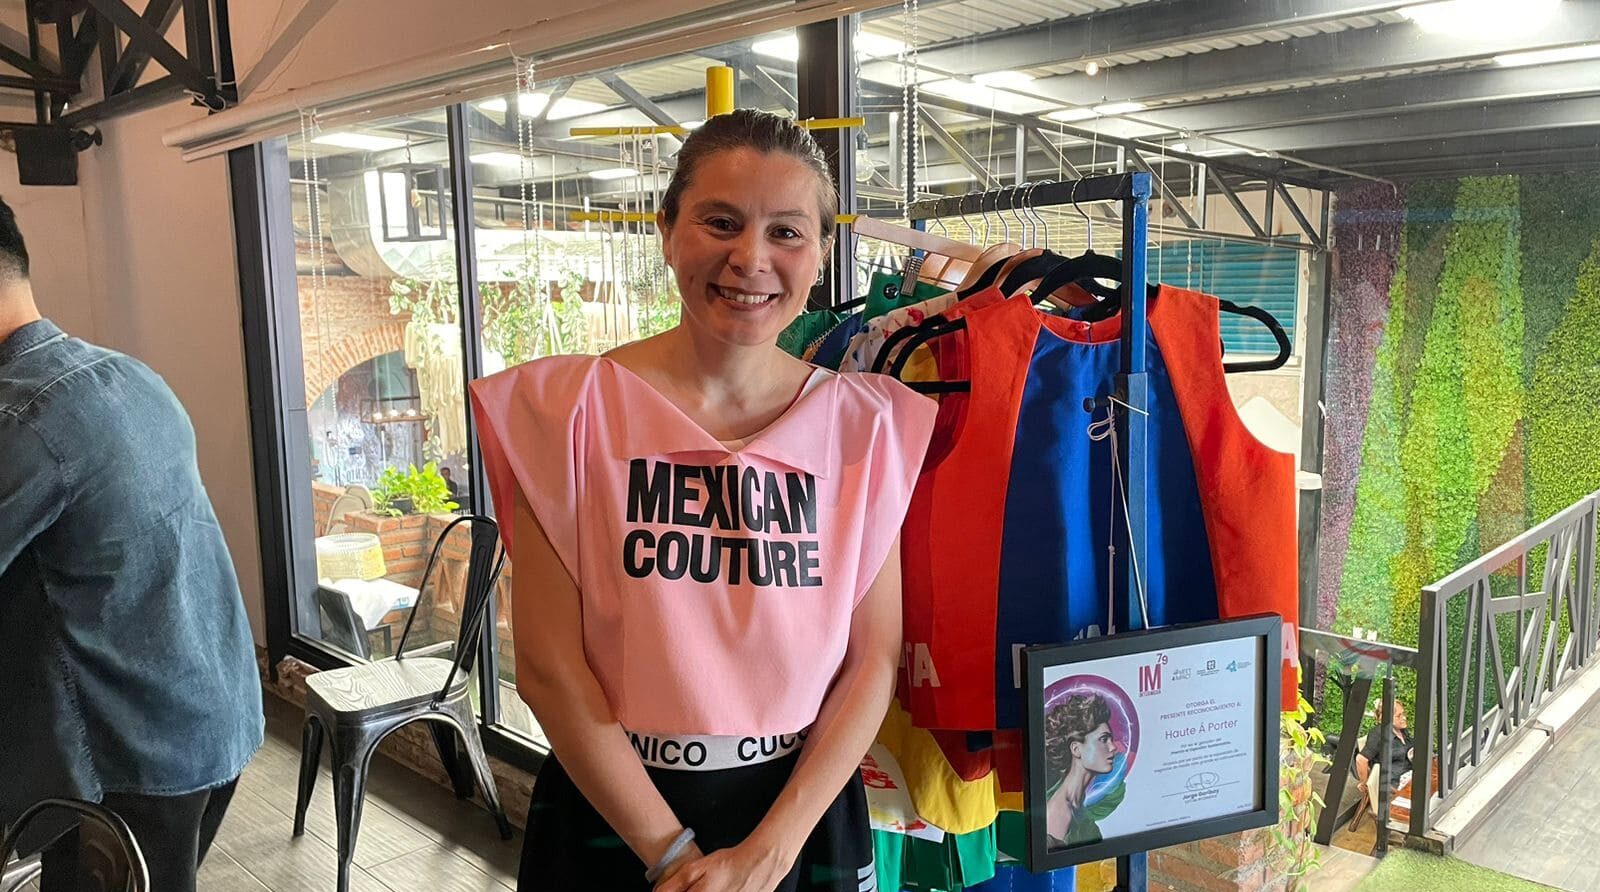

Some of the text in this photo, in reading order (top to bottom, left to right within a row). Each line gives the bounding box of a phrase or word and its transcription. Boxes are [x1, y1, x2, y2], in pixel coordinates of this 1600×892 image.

[627, 458, 817, 533] MEXICAN
[623, 529, 823, 587] COUTURE
[1139, 663, 1161, 692] IM
[1160, 711, 1186, 721] PRESENTE
[1187, 702, 1236, 716] RECONOCIMIENTO
[1185, 699, 1209, 709] OTORGA
[1165, 726, 1196, 740] Haute
[1208, 719, 1239, 732] Porter
[626, 733, 707, 767] NICO
